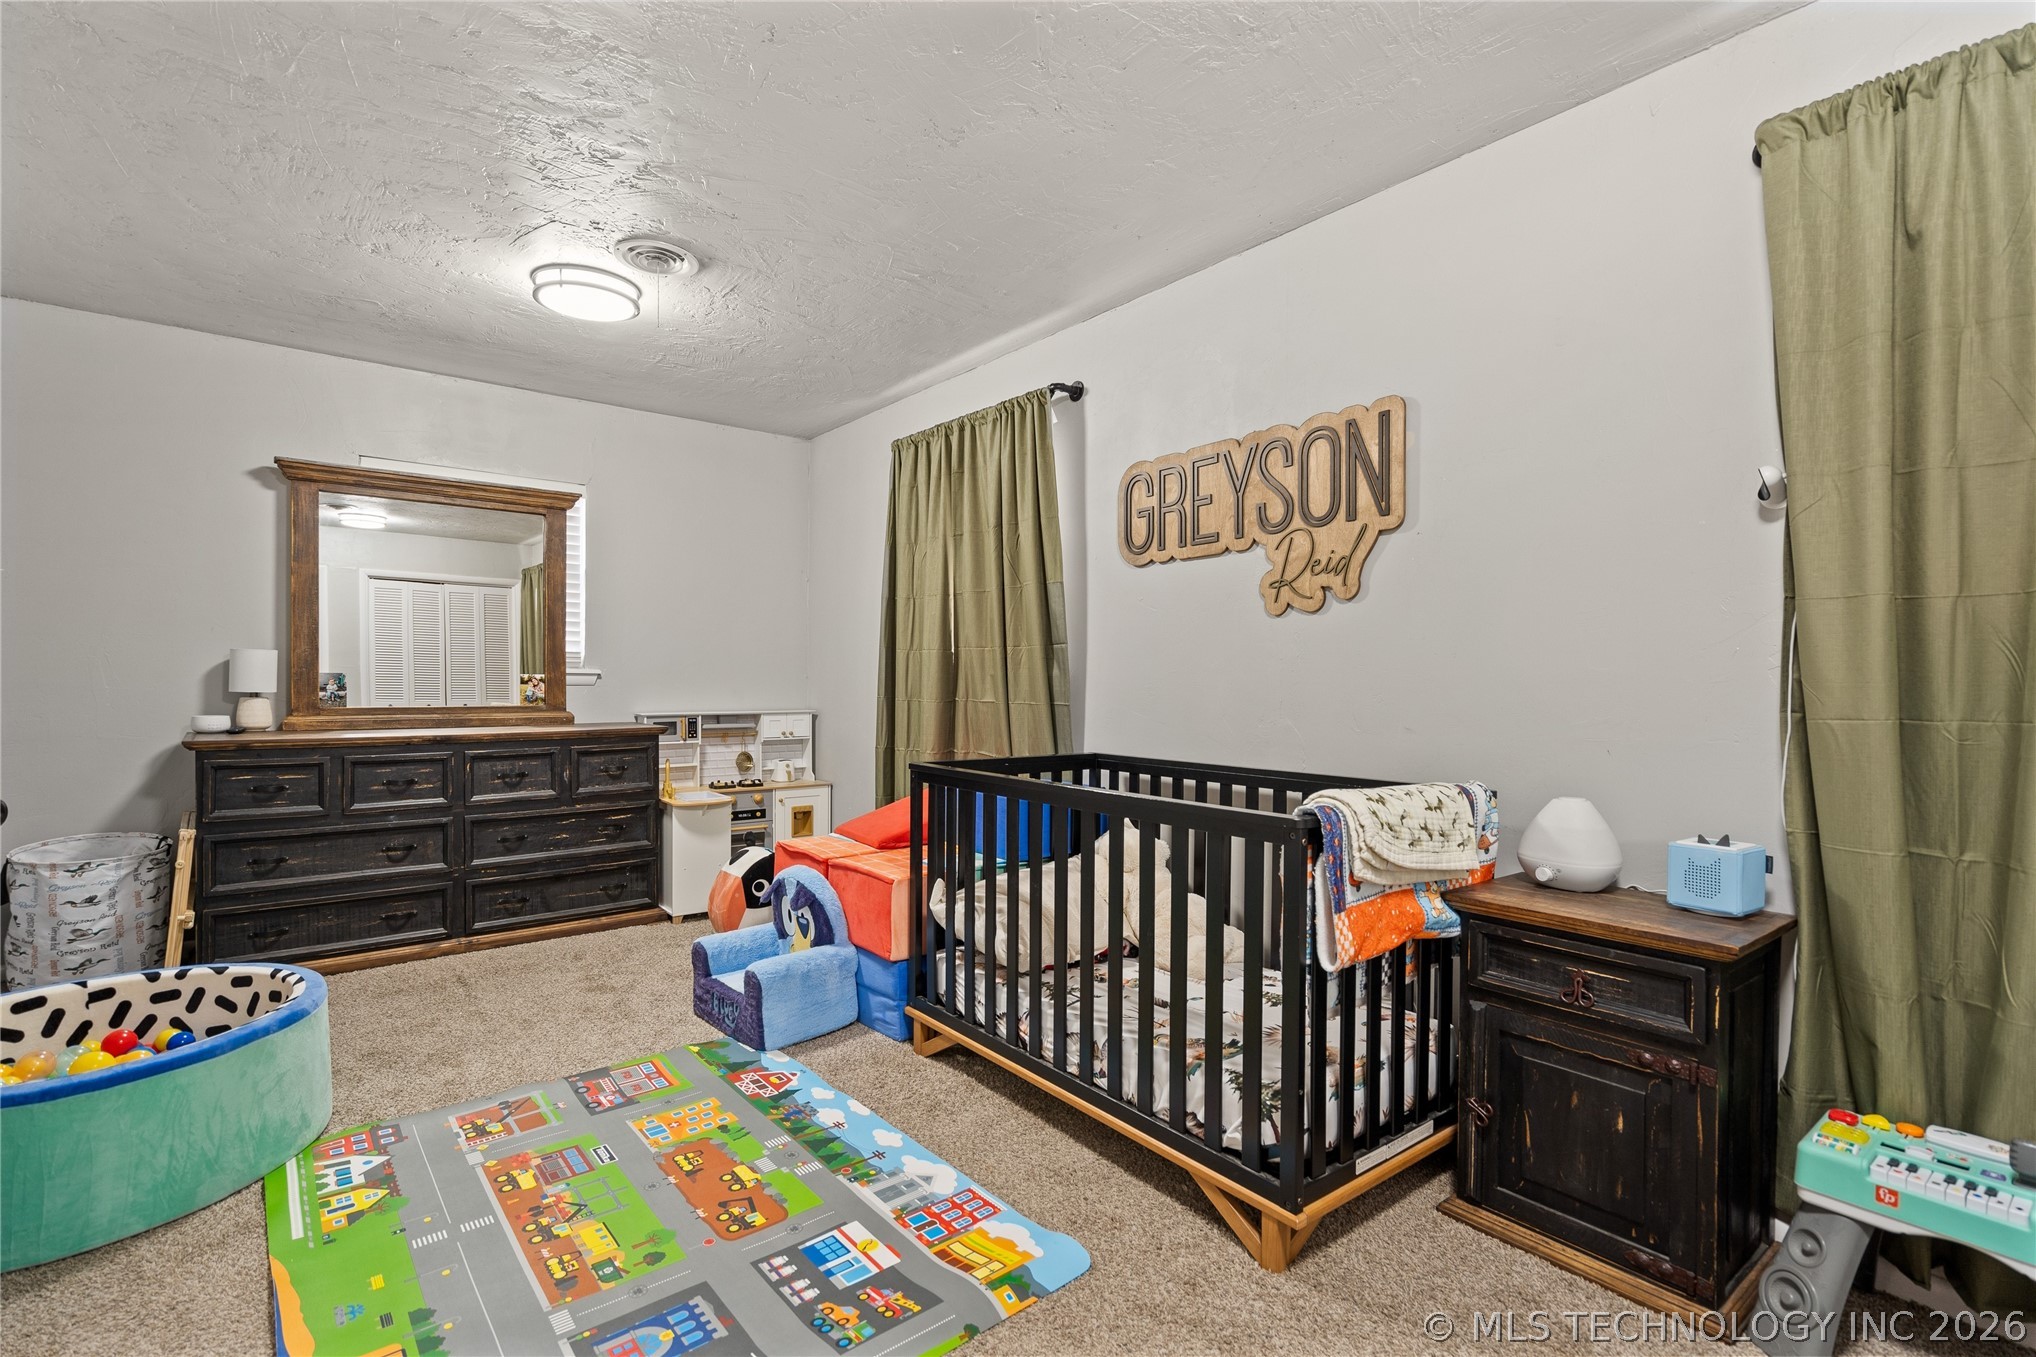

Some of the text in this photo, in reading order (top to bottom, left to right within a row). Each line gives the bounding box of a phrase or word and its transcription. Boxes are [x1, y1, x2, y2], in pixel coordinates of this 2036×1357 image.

[1123, 409, 1391, 556] GREYSON
[1268, 523, 1368, 603] Reid
[1878, 1187, 1896, 1204] fp
